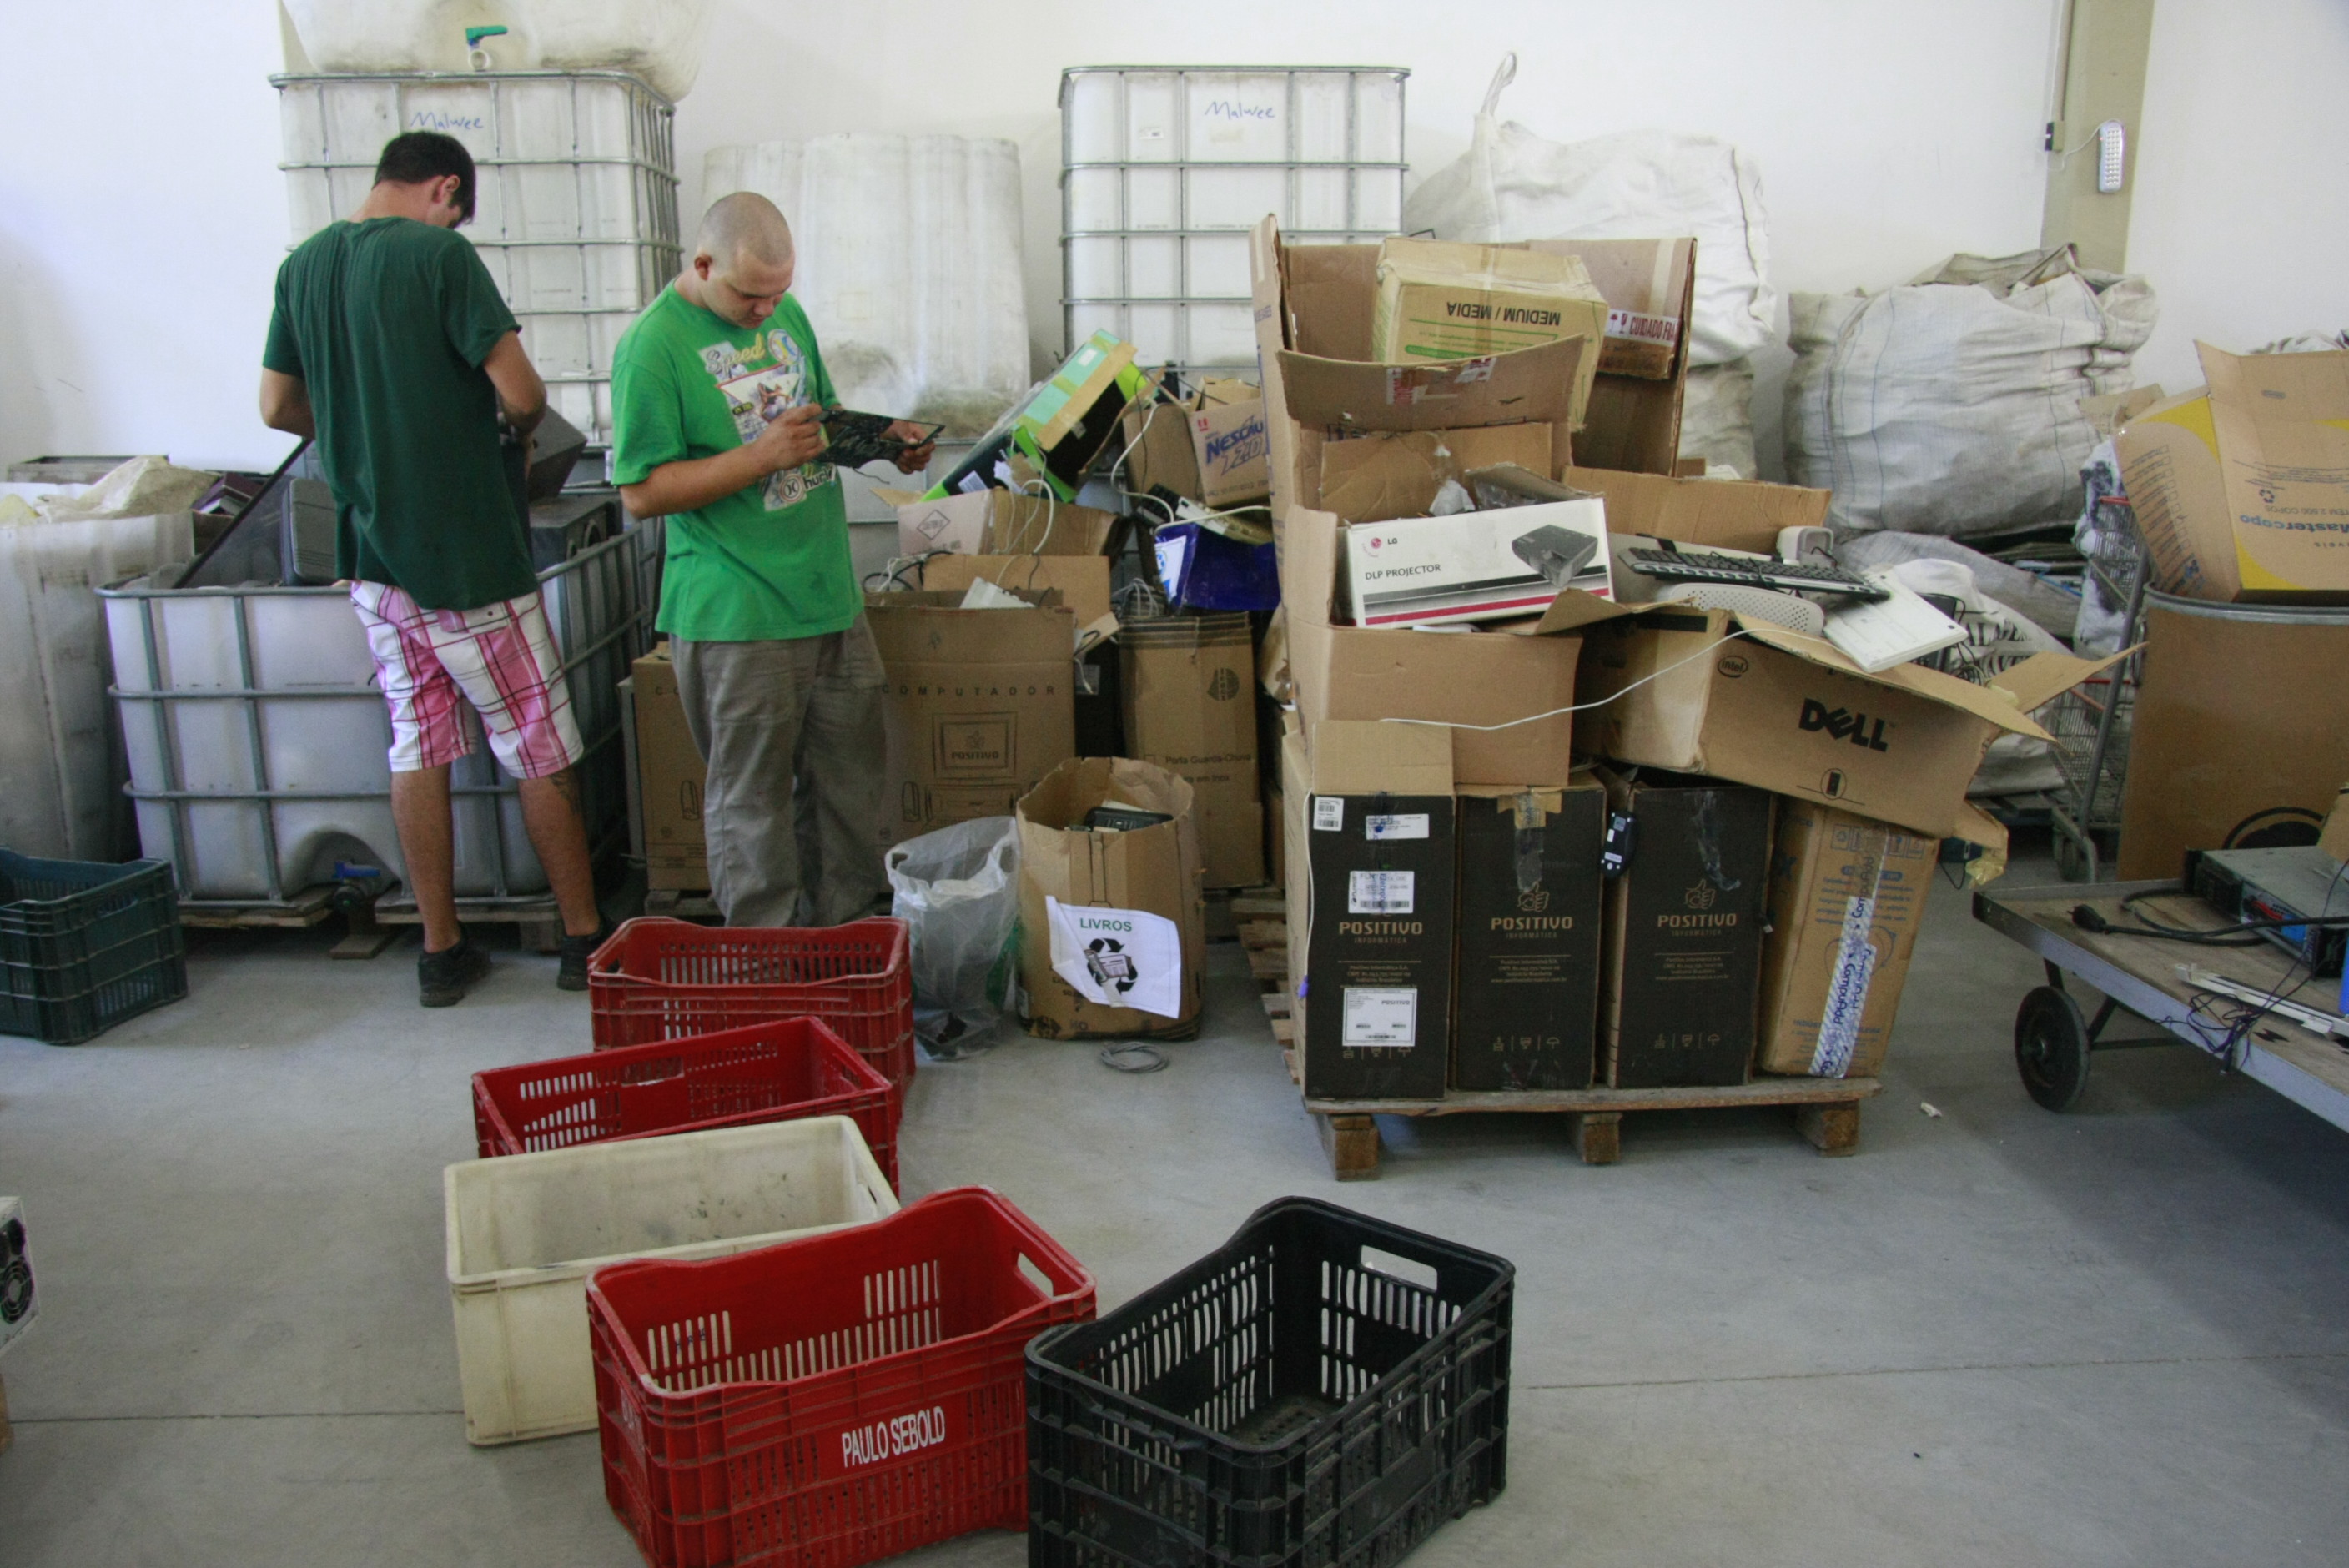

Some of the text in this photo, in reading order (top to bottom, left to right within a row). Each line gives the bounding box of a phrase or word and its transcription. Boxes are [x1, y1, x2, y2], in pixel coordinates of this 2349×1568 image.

[1204, 101, 1275, 119] Malwee
[410, 112, 483, 131] Malwee
[1446, 301, 1492, 319] MEDIA
[1503, 307, 1561, 326] MEDIUM
[1629, 316, 1663, 339] CUIDADO
[705, 332, 765, 379] Speed
[1206, 421, 1264, 465] NESCAU
[1365, 564, 1441, 580] DLP PROJECTOR
[882, 684, 1055, 697] COMPUTADOR
[1798, 697, 1888, 752] DELL
[1166, 756, 1188, 764] Porta
[1080, 918, 1133, 932] LIVROS
[1338, 921, 1423, 935] POSITIVO
[1491, 917, 1573, 931] POSITIVO
[1657, 913, 1738, 927] POSITIVO
[842, 1405, 946, 1468] PAULO SEBOLD
